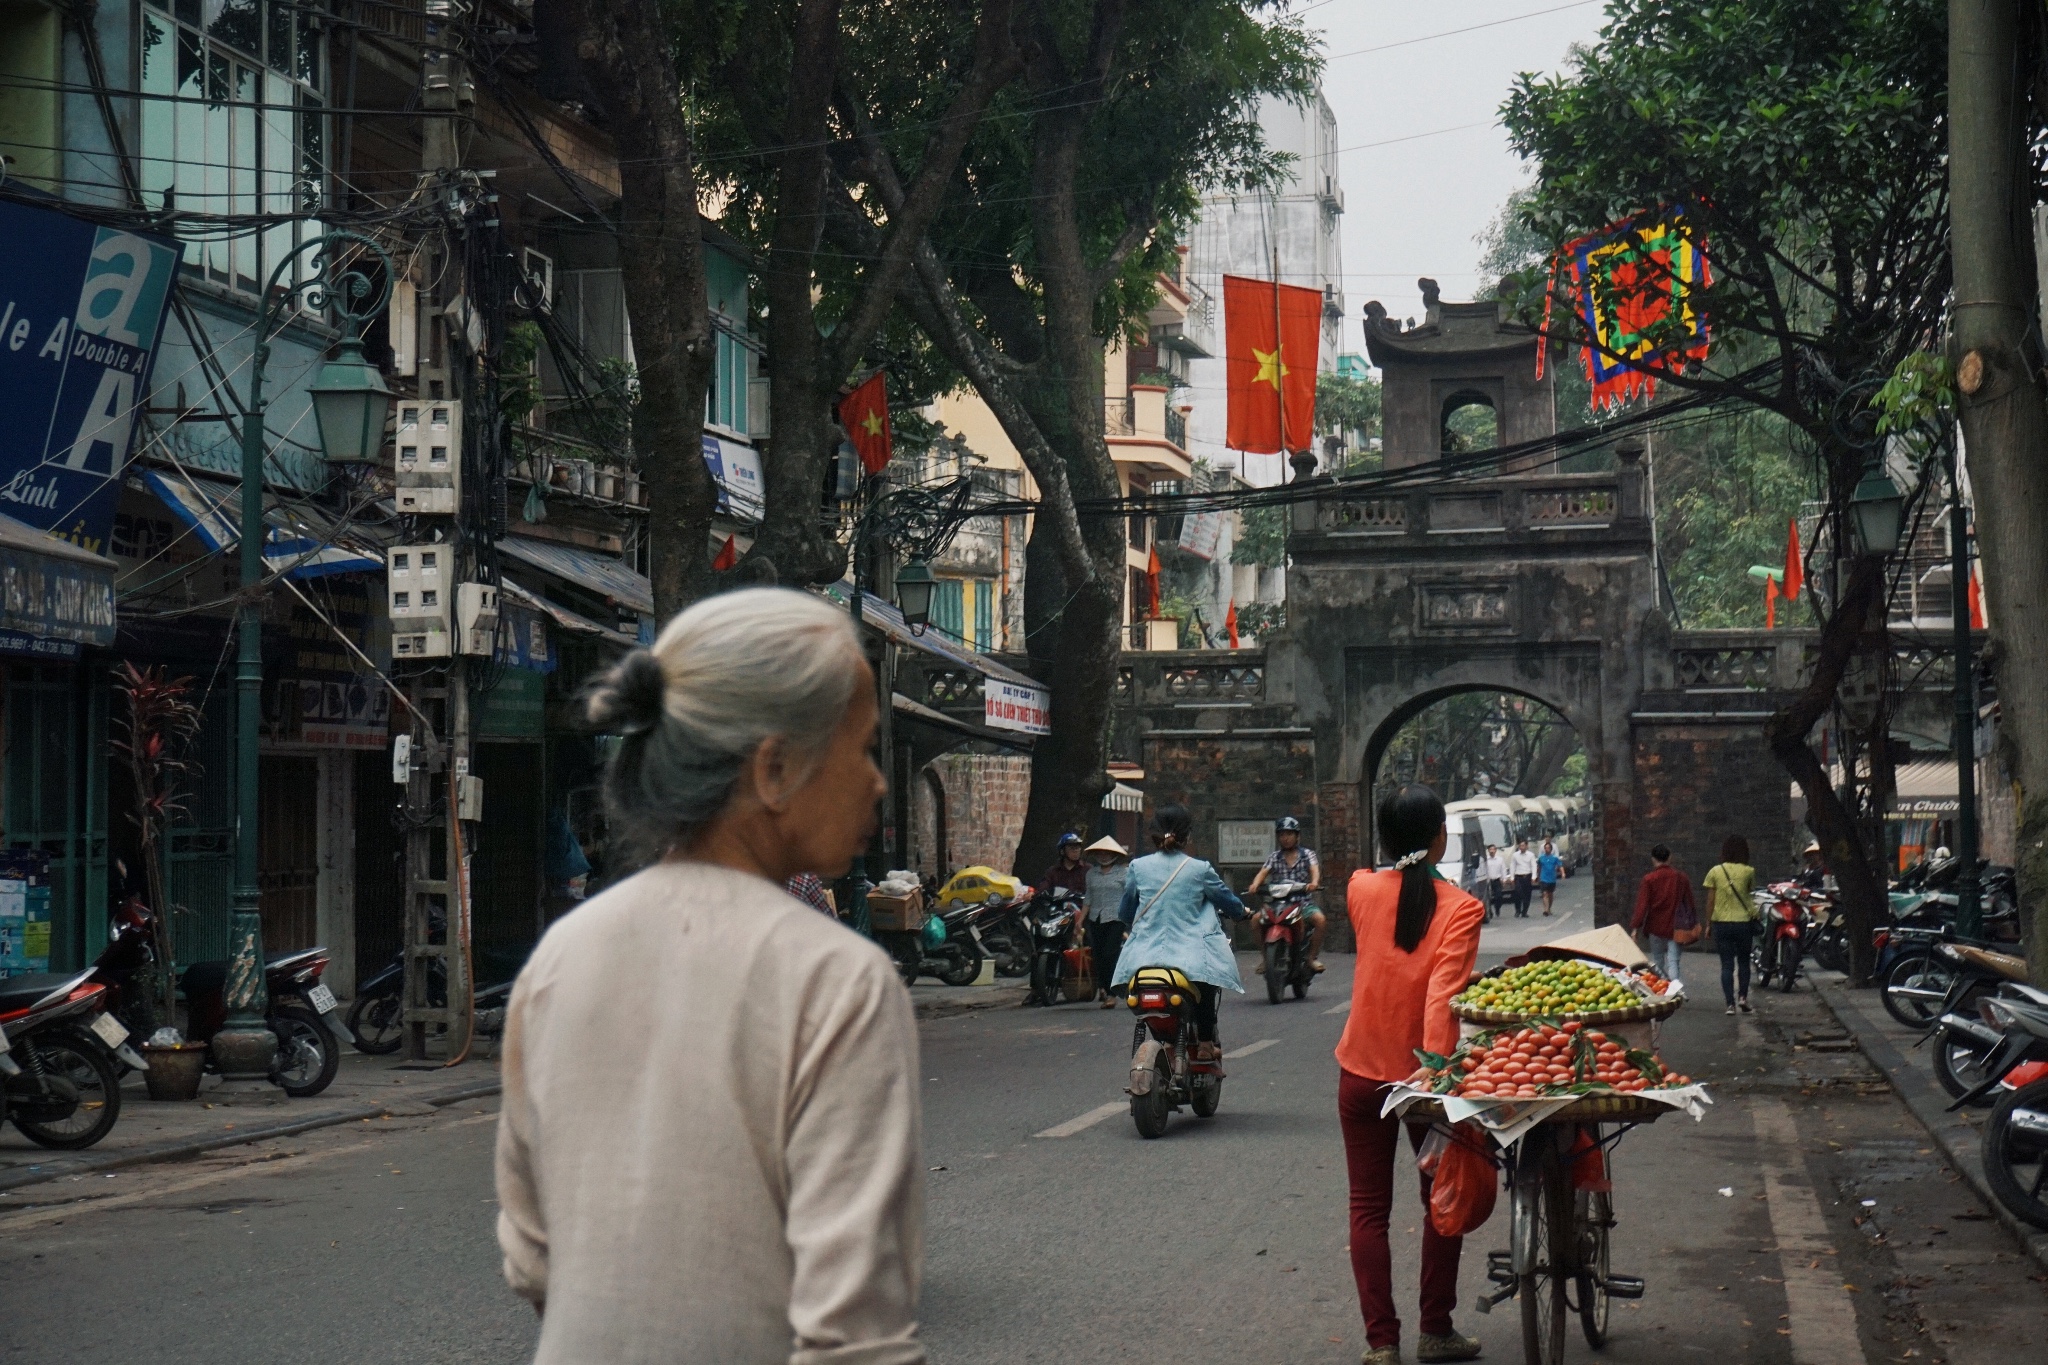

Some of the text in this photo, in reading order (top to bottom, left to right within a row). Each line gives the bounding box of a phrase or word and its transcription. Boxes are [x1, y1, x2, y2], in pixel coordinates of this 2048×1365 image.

[76, 234, 153, 348] a
[38, 316, 70, 362] A
[74, 334, 146, 373] Double A
[66, 367, 135, 480] A
[0, 467, 59, 510] Linh
